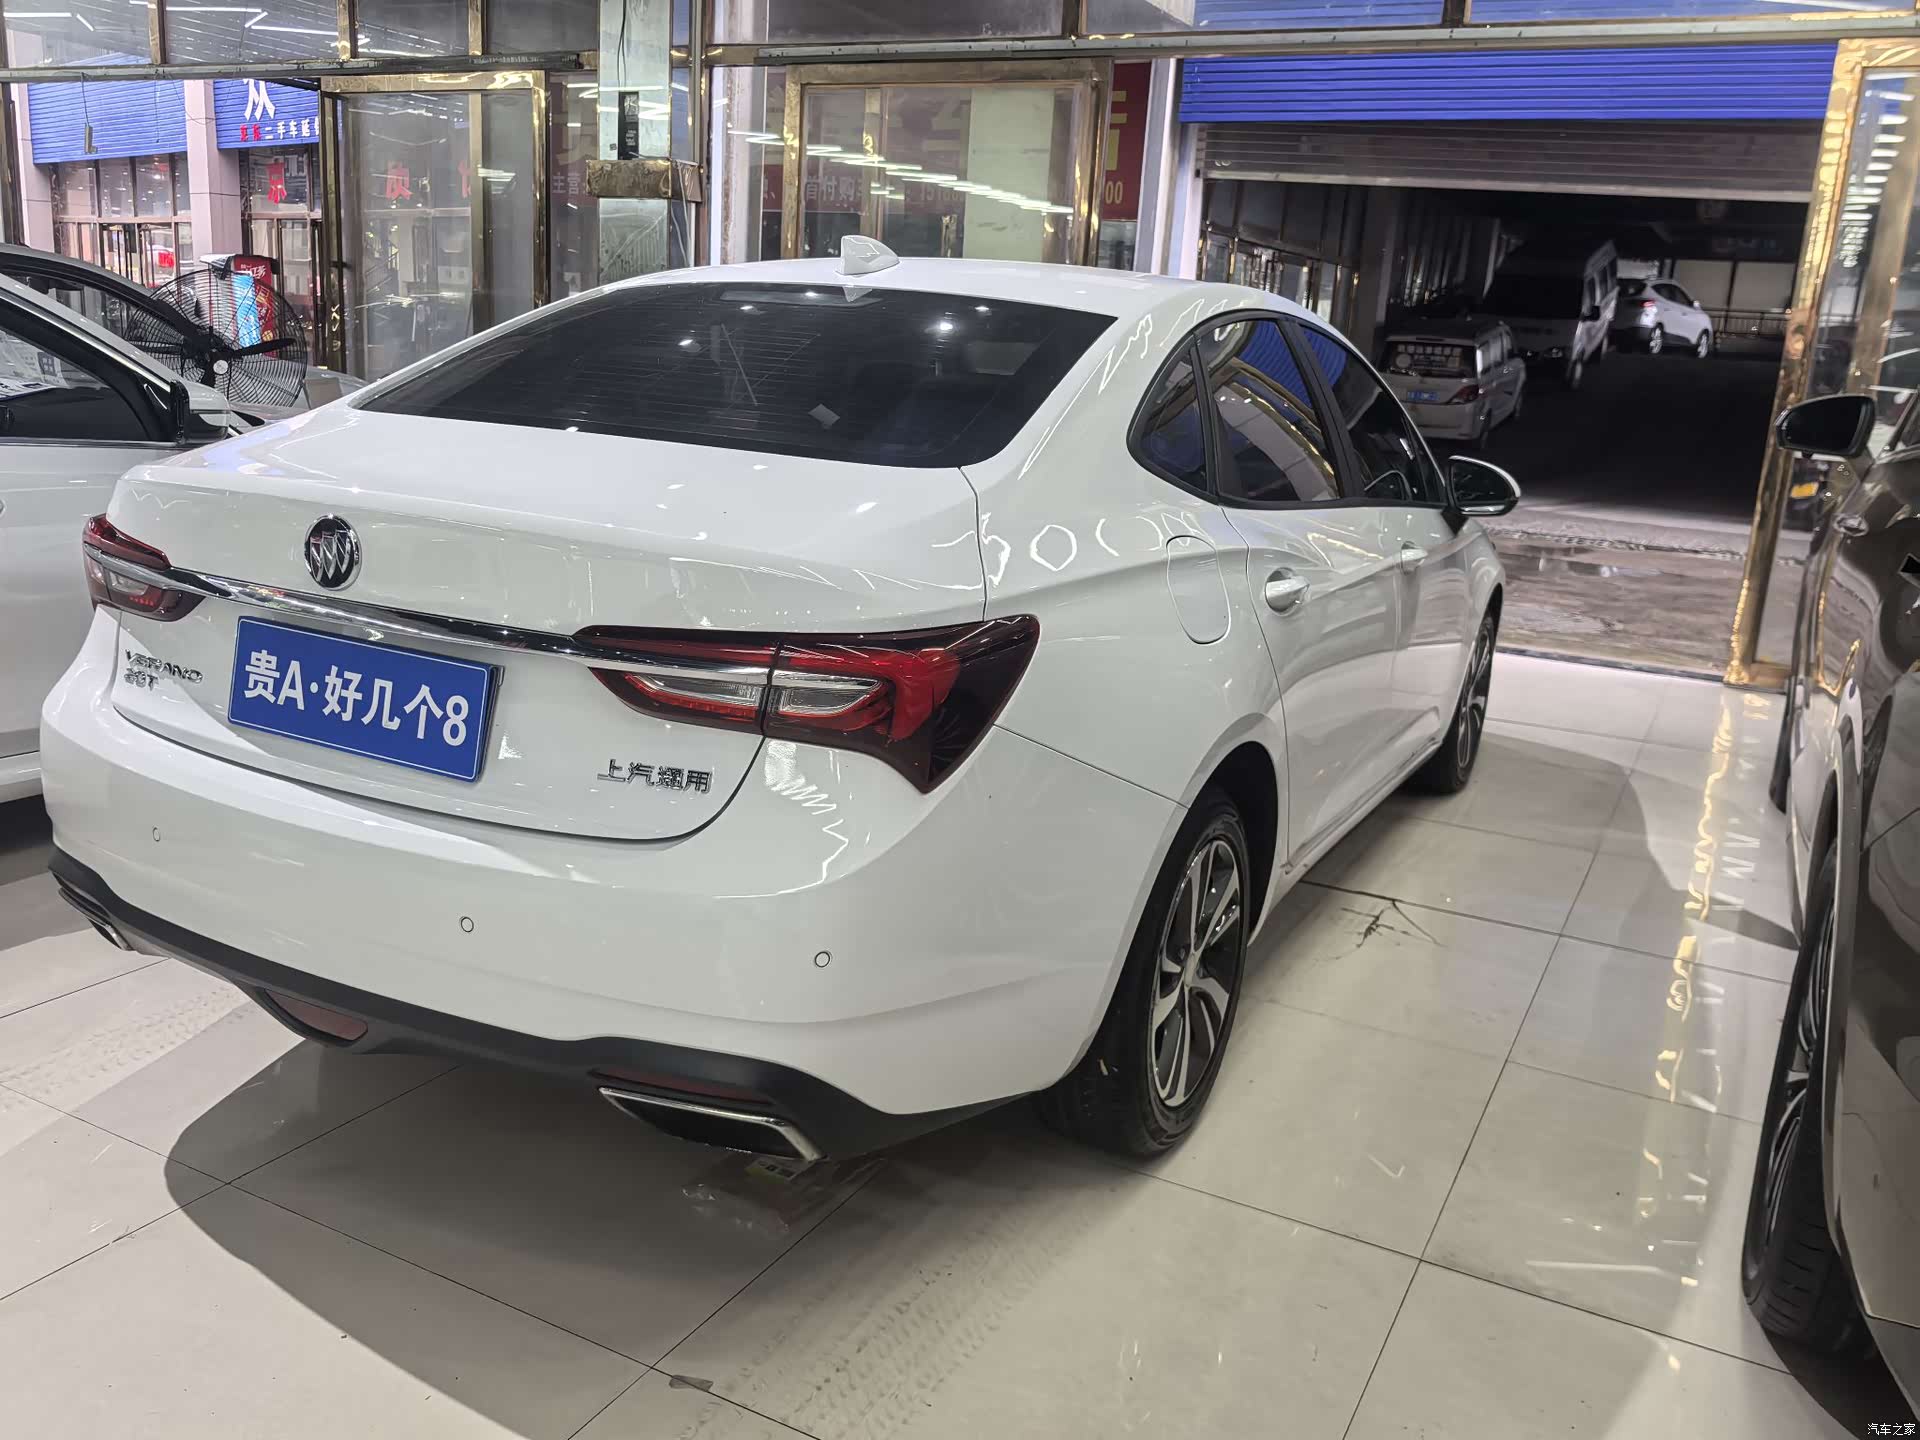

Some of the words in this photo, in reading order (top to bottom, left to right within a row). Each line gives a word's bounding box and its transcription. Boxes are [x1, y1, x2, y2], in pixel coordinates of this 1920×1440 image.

[805, 174, 864, 202] 首付购
[596, 758, 713, 795] 上汽通用
